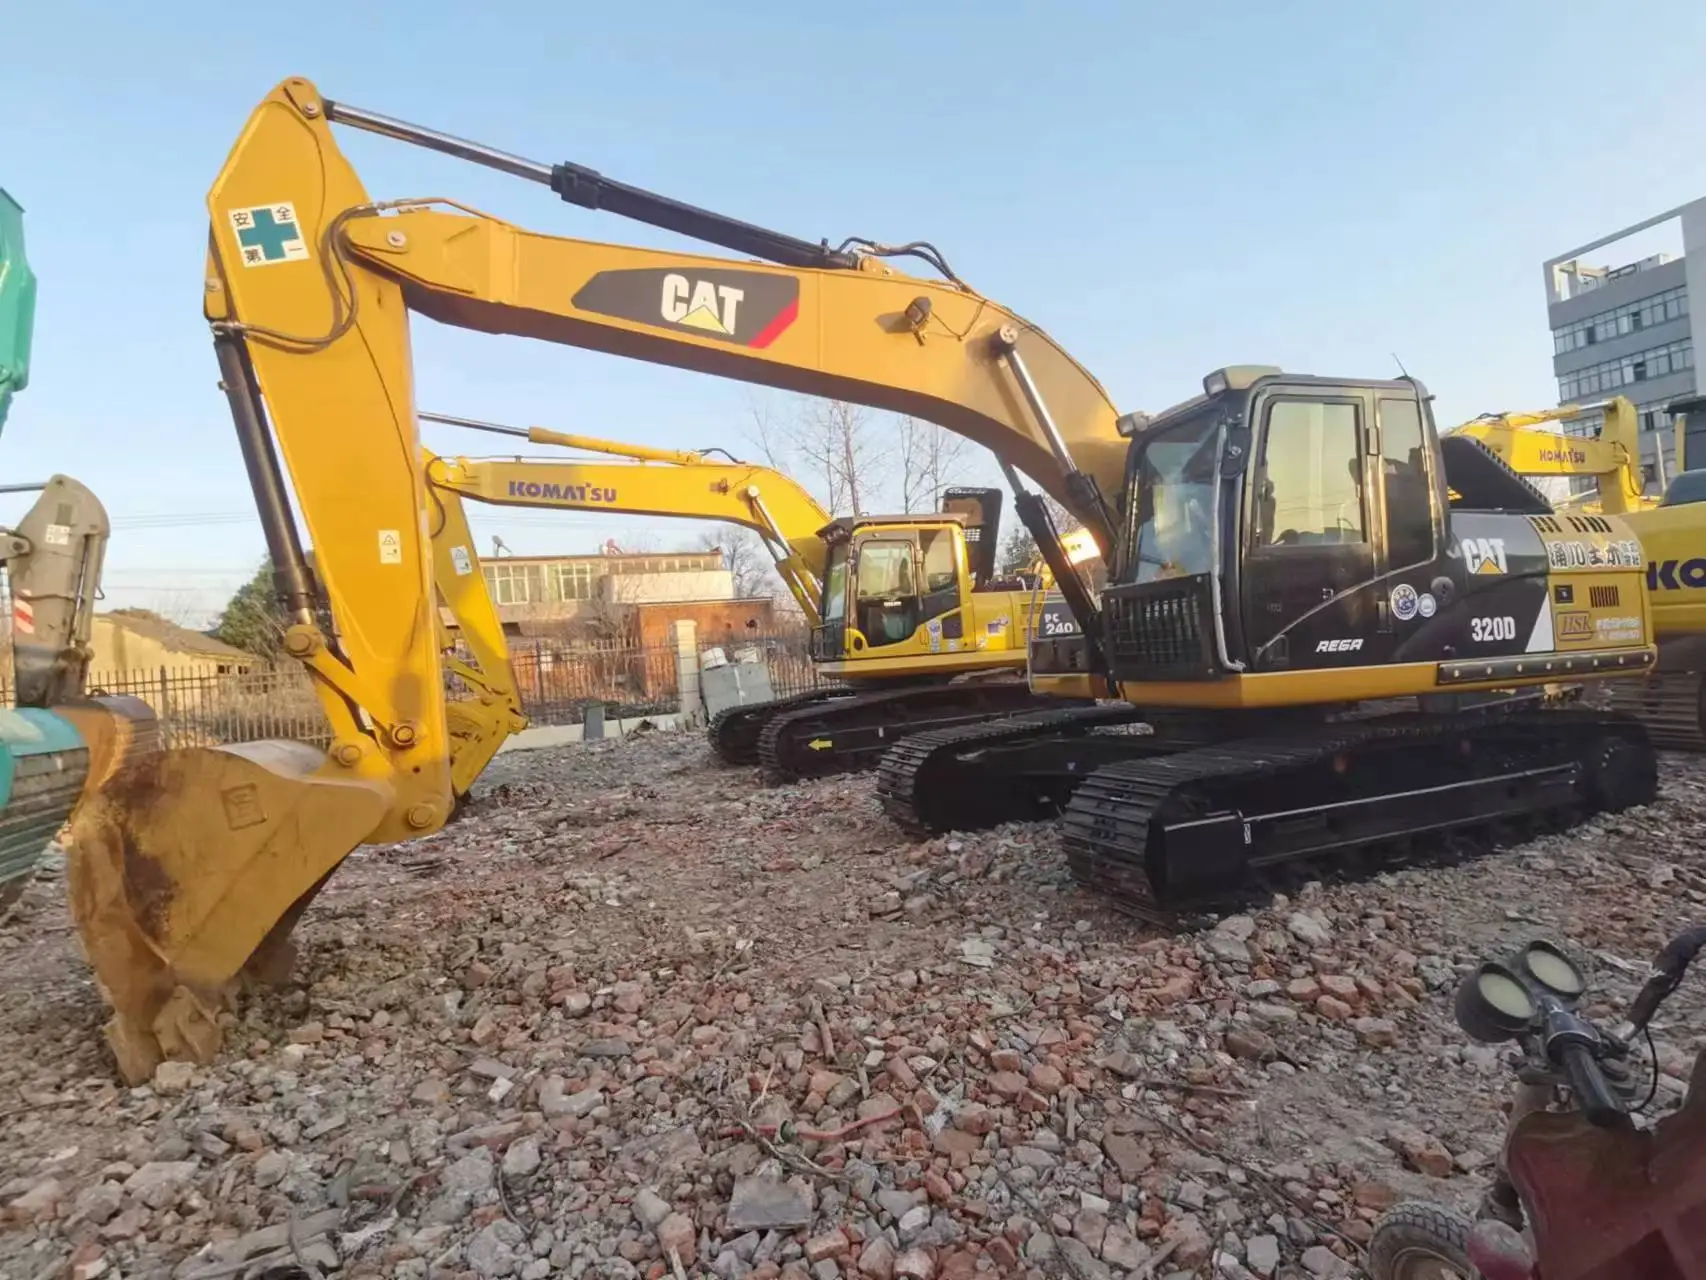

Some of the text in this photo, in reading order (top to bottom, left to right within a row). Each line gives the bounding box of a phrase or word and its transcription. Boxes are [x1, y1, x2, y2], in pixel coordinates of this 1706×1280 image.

[232, 206, 293, 226] 安全
[244, 247, 304, 264] 第一
[660, 273, 745, 336] CAT
[1538, 448, 1586, 464] KOMATSU
[508, 480, 617, 504] KOMATSU
[1461, 538, 1509, 575] CAT
[1044, 613, 1060, 623] PC
[1046, 622, 1074, 635] 240
[1471, 616, 1516, 642] 320D
[1315, 638, 1363, 654] REGA
